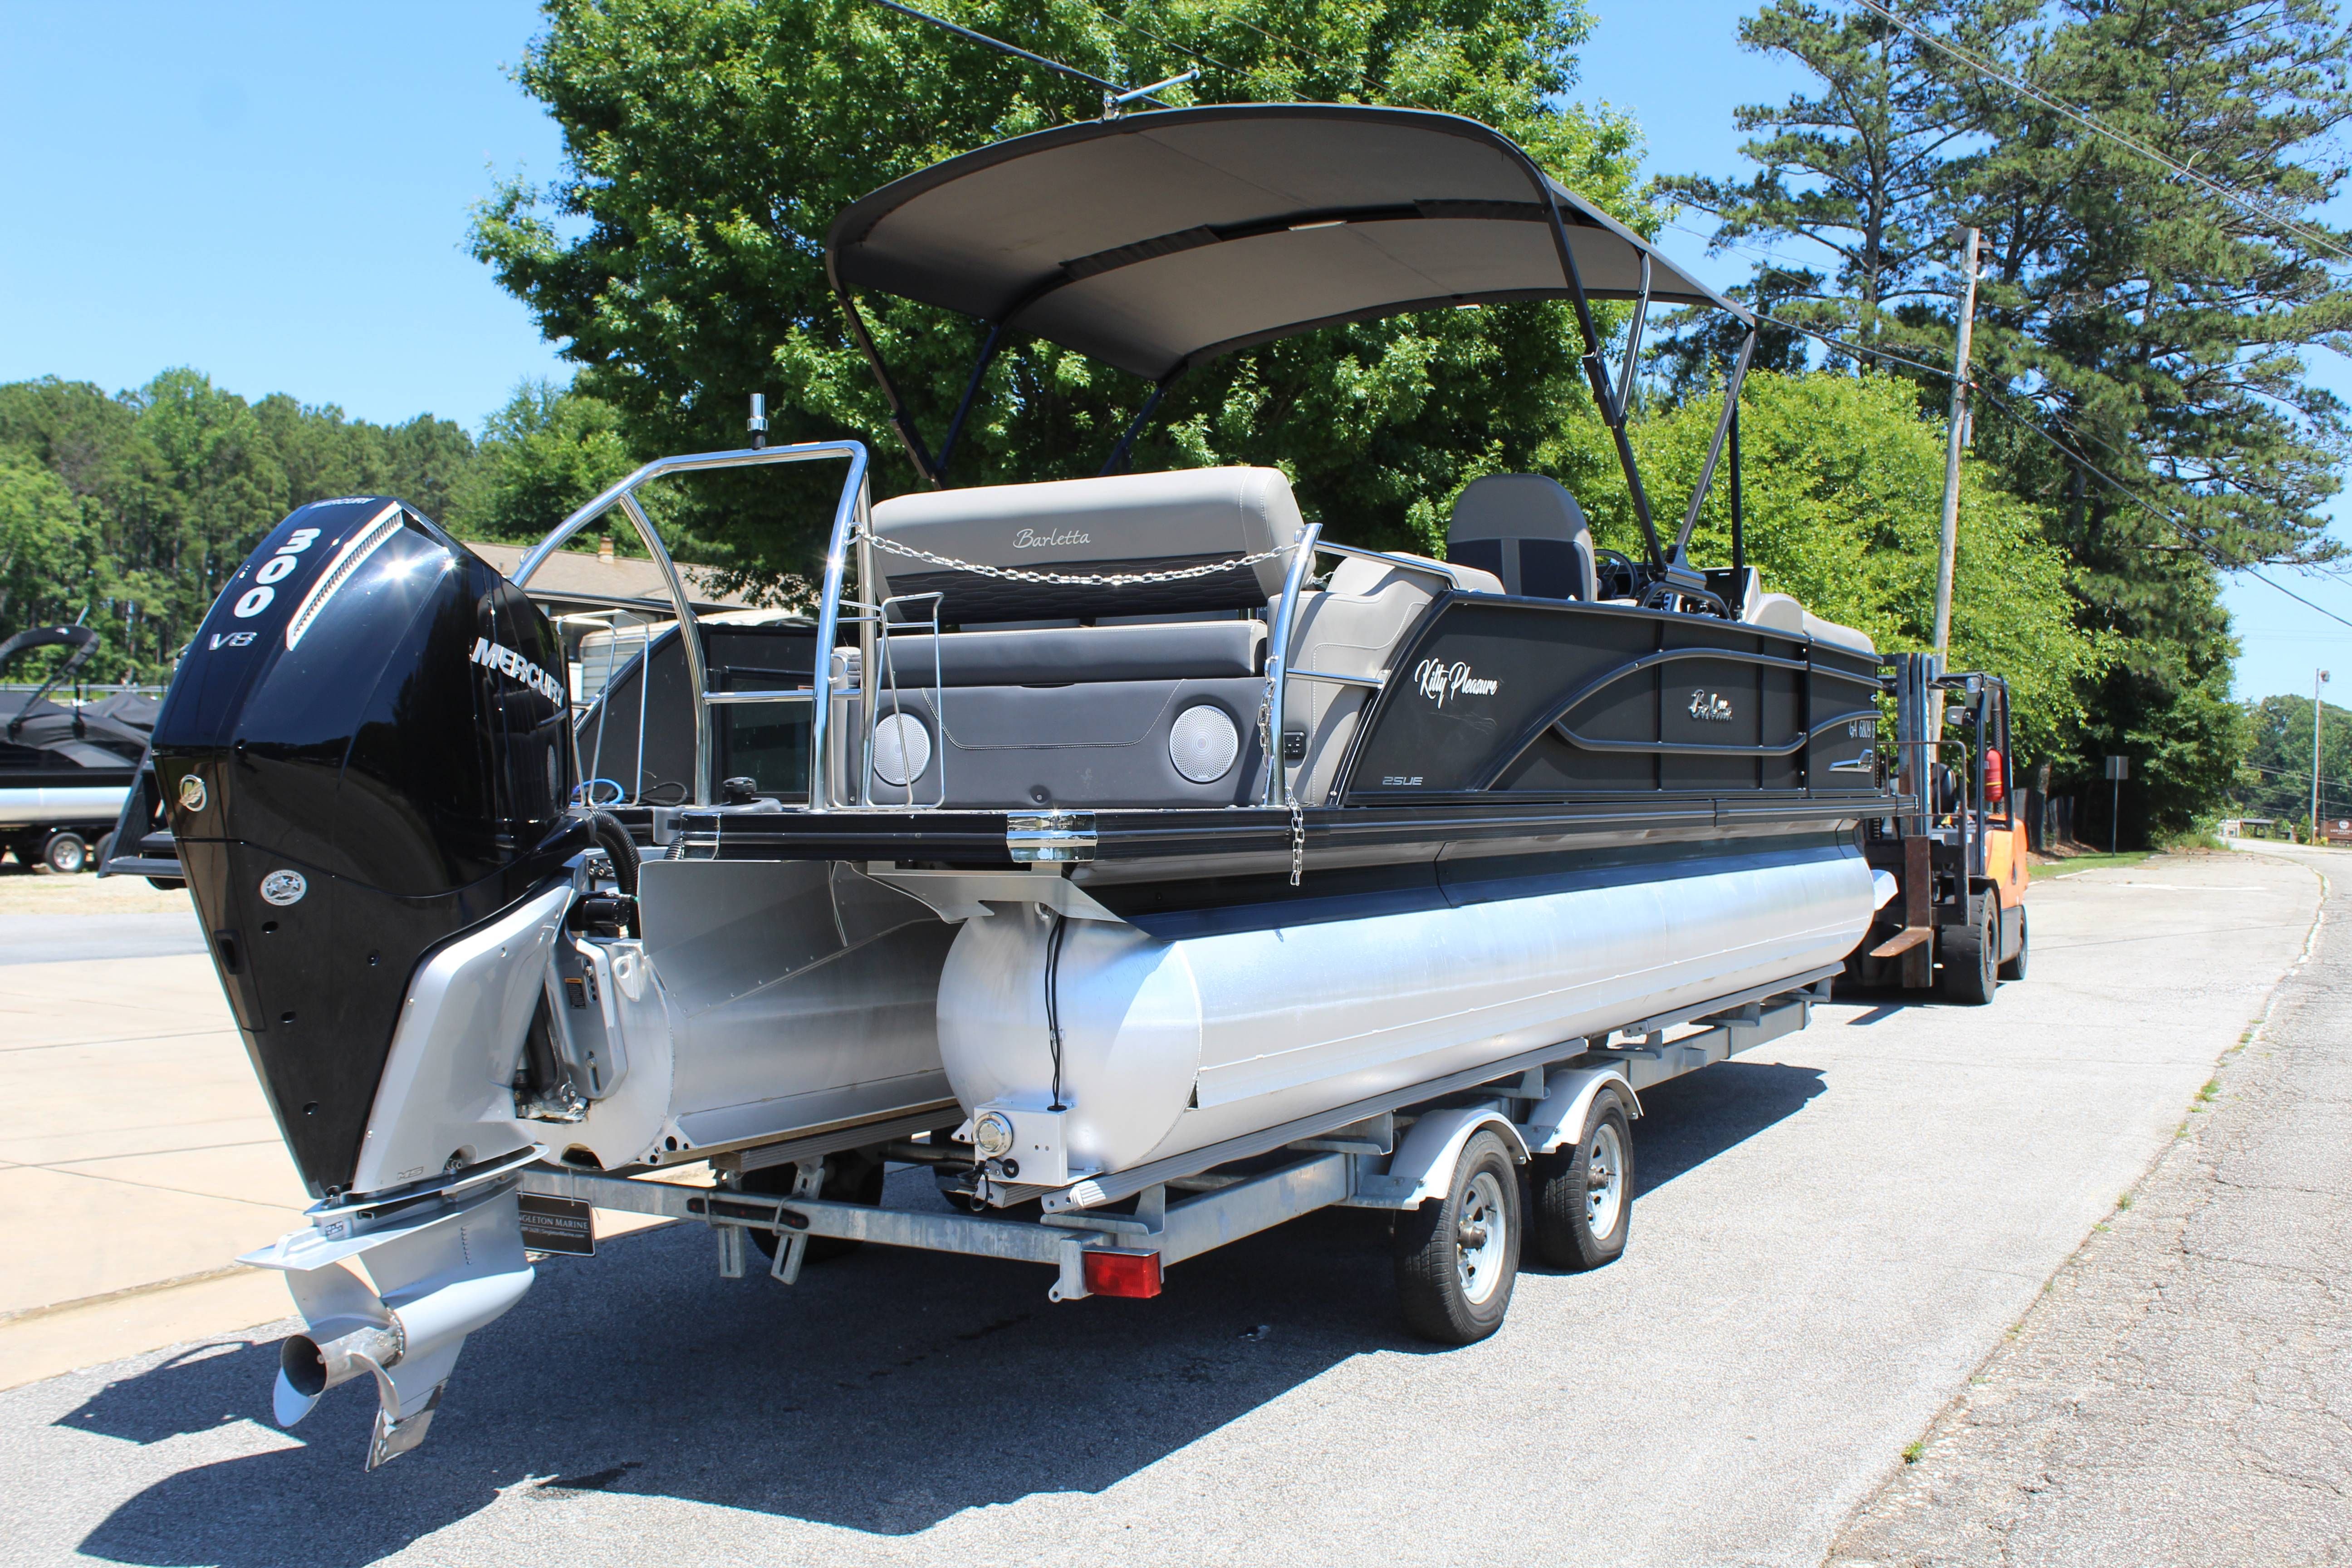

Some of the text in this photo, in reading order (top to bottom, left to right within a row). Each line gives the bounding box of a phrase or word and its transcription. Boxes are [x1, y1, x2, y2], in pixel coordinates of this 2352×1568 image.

[1013, 528, 1091, 549] Barletta
[234, 528, 322, 618] 300
[209, 632, 258, 651] V8
[471, 637, 565, 708] MERCURY
[1414, 658, 1498, 709] Kitty Pleasure
[1382, 776, 1423, 785] 25UE
[555, 1218, 589, 1230] MARINE
